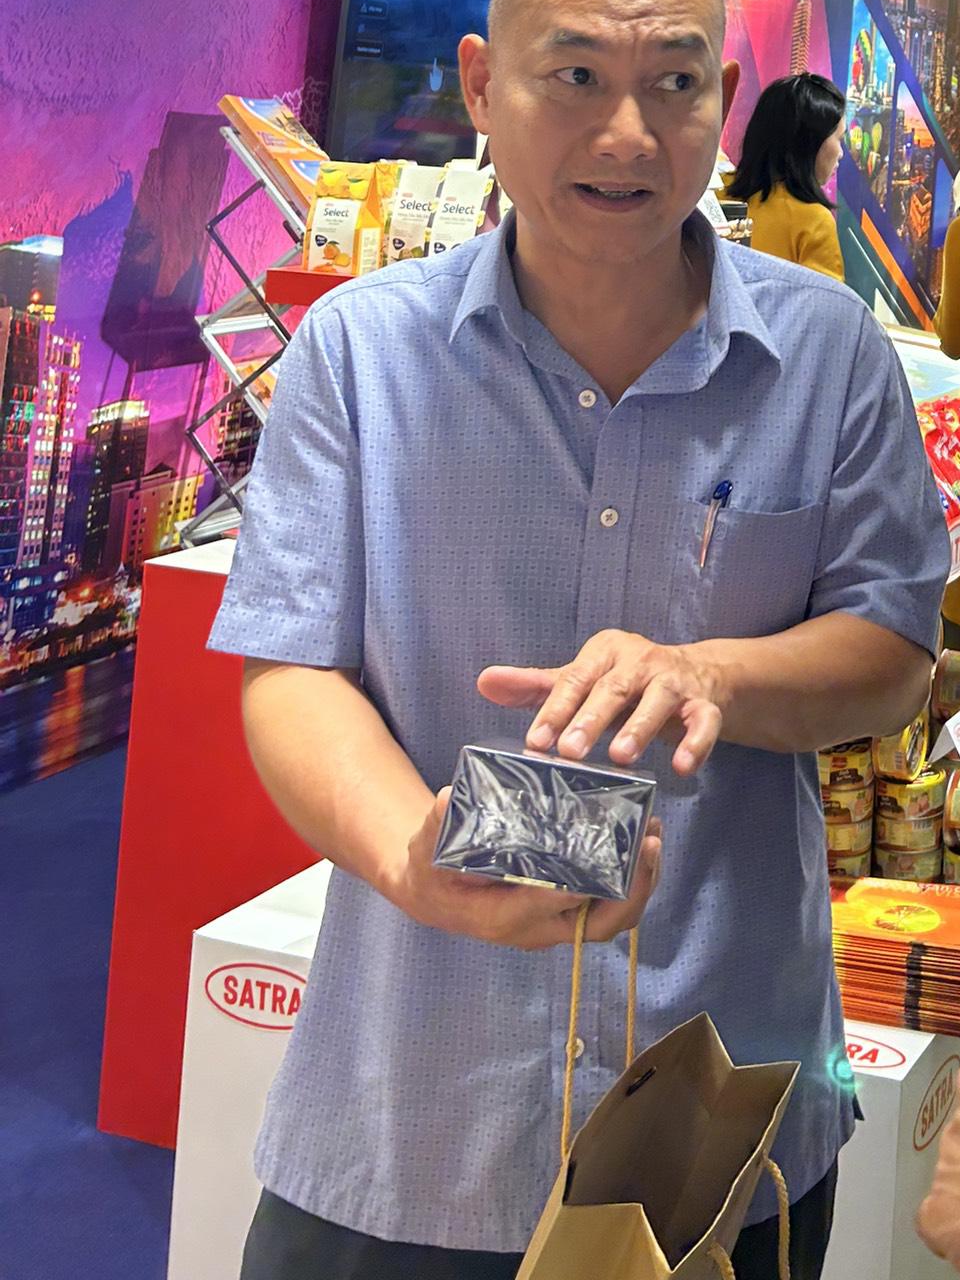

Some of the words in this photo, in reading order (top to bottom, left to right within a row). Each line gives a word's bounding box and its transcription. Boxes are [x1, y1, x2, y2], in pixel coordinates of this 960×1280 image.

[399, 199, 434, 212] Select
[441, 202, 476, 215] Select
[323, 207, 350, 218] Select
[223, 975, 302, 1017] SATRA
[920, 1067, 953, 1139] SATRA
